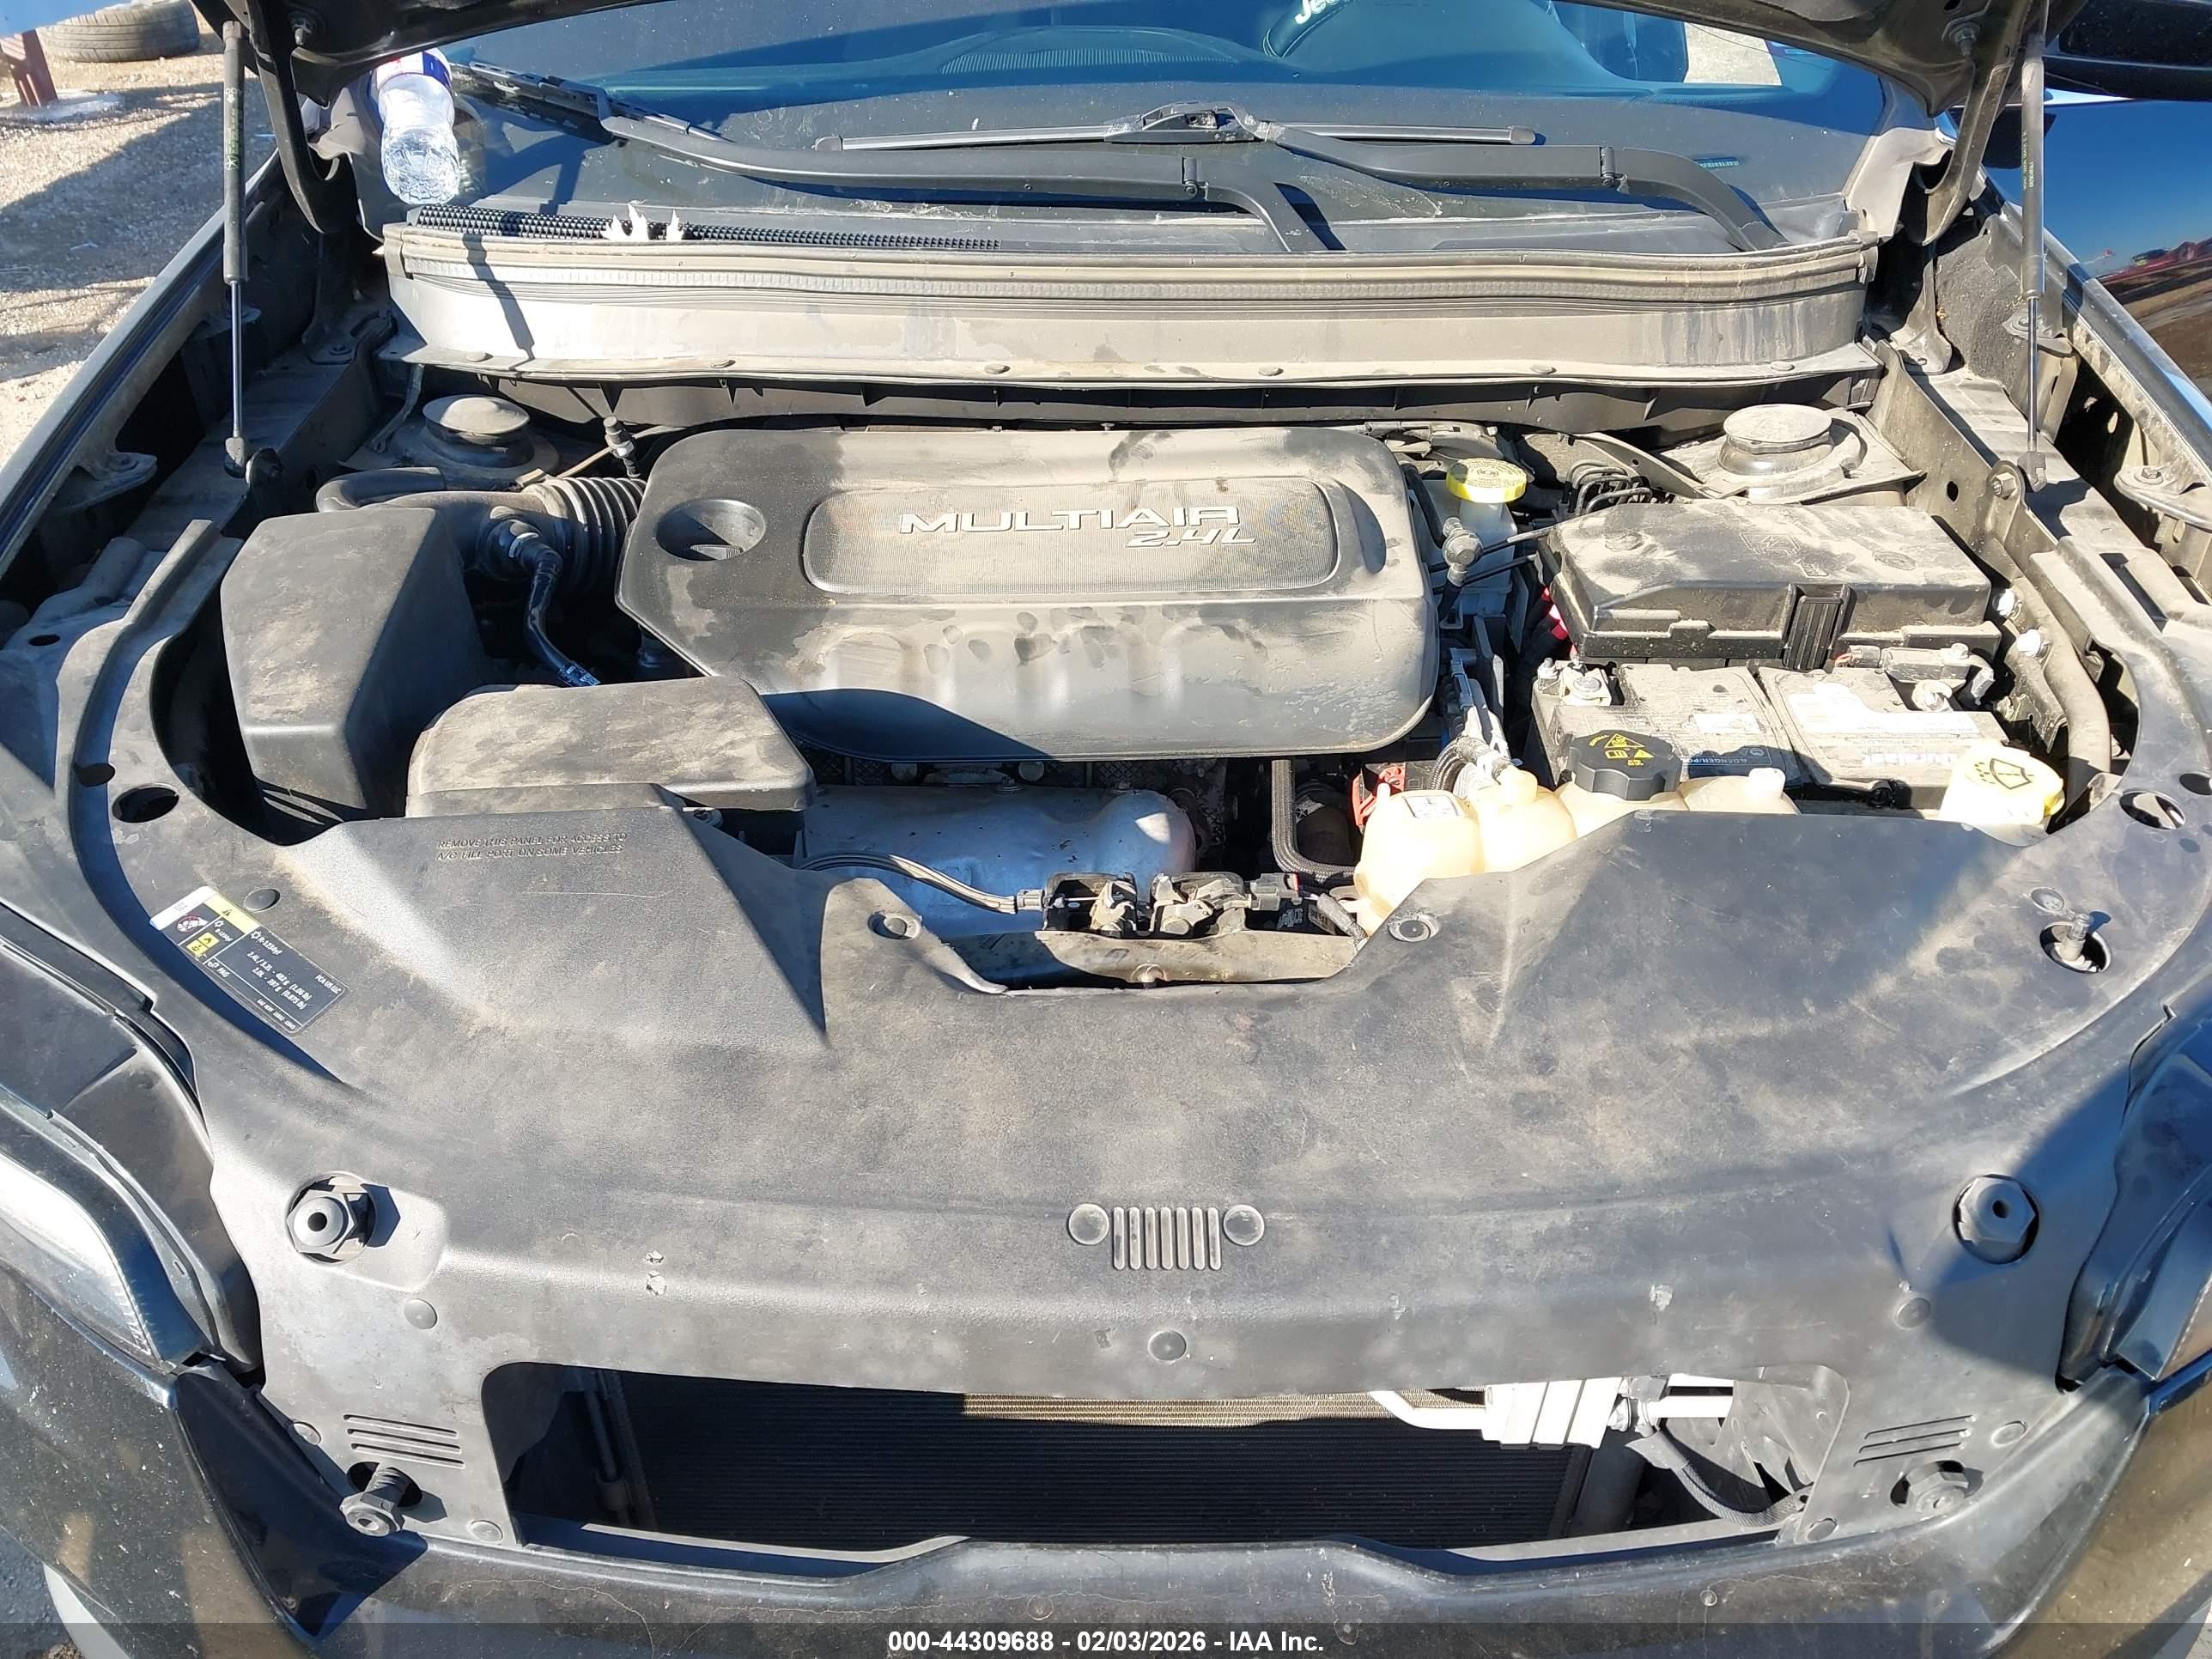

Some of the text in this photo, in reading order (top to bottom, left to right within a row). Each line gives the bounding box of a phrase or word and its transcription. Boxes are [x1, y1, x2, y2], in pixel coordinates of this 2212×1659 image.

[900, 507, 1241, 534] MULTIAIR
[1125, 528, 1256, 549] 2.4L
[437, 833, 627, 848] REMOVE THIS PANEL FOR ACCESS TO
[435, 843, 624, 860] A/C FILL PORT ON SOME VEHICLES
[256, 937, 283, 955] R-1234yf
[216, 968, 230, 978] PAG
[315, 975, 326, 984] FCA
[331, 985, 342, 994] LLC
